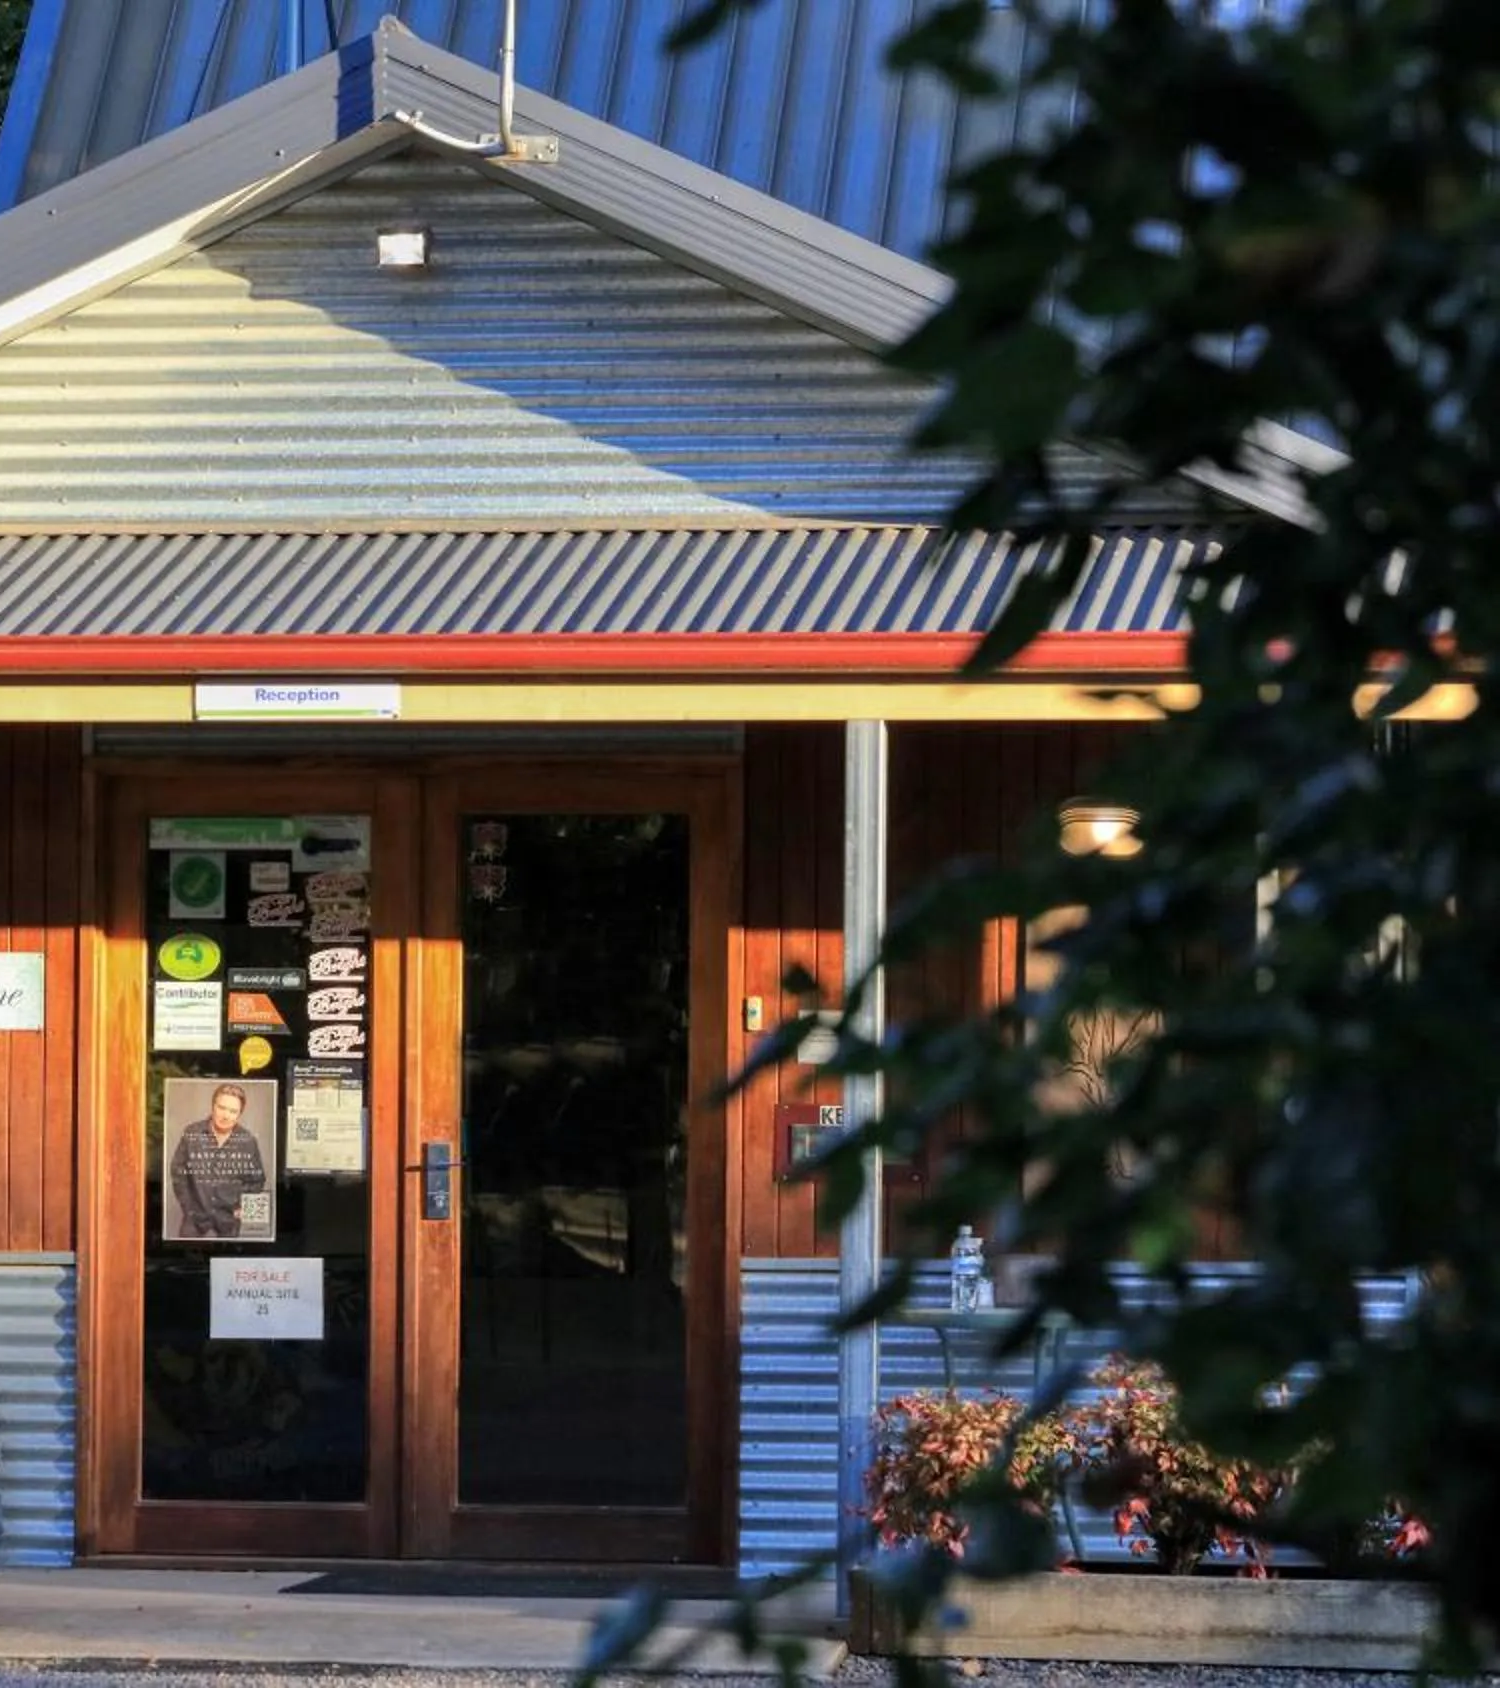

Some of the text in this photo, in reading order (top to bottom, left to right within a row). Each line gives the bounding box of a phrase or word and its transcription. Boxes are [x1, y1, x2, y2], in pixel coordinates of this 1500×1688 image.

[254, 688, 340, 704] Reception
[235, 1271, 291, 1283] FOR SALE
[225, 1288, 300, 1300] ANNUAL SITE
